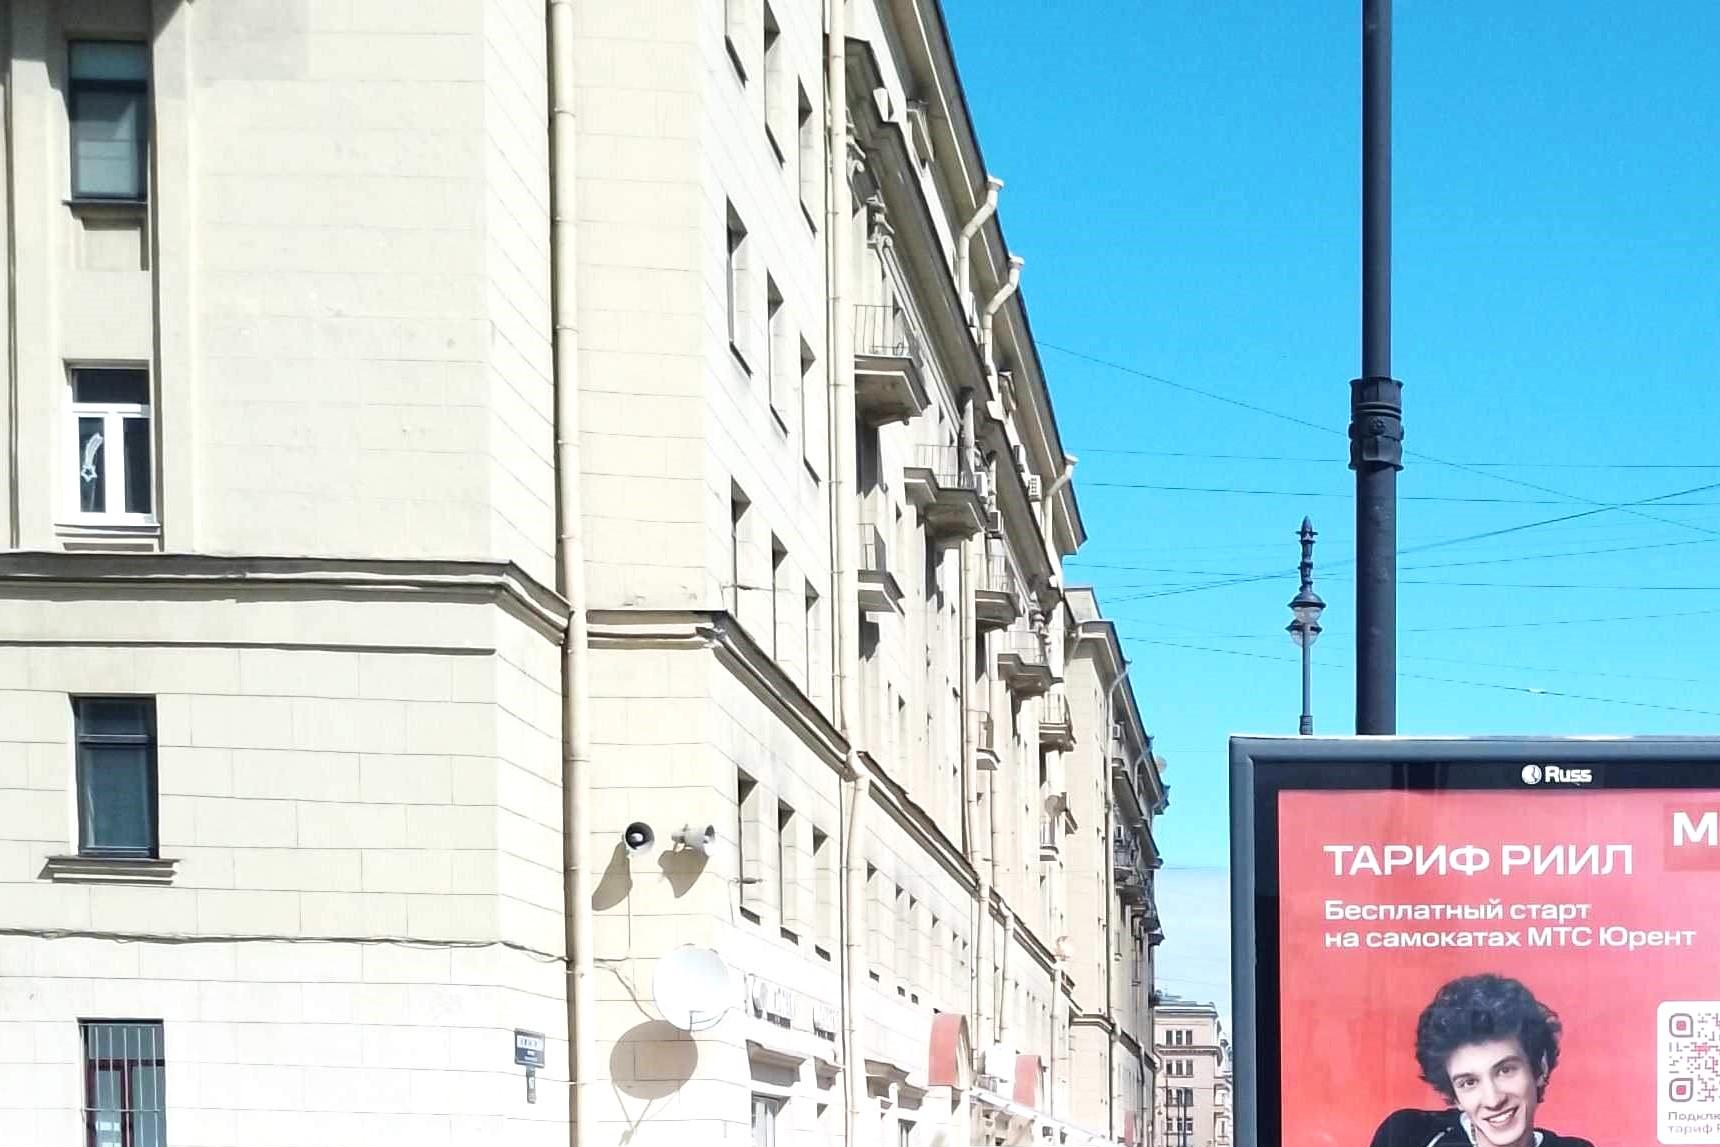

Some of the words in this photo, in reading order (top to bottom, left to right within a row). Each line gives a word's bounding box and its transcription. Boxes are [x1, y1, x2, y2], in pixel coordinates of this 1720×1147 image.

[1544, 765, 1593, 783] Russ
[1324, 843, 1491, 878] ТАРИФ
[1501, 844, 1634, 876] РИИЛ
[1324, 899, 1503, 926] Бесплатный
[1510, 904, 1590, 926] старт
[1324, 931, 1360, 949] на
[1366, 929, 1521, 948] самокатах
[1528, 927, 1592, 948] МТС
[1600, 927, 1696, 951] Юрент
[1668, 1124, 1713, 1135] тариф
